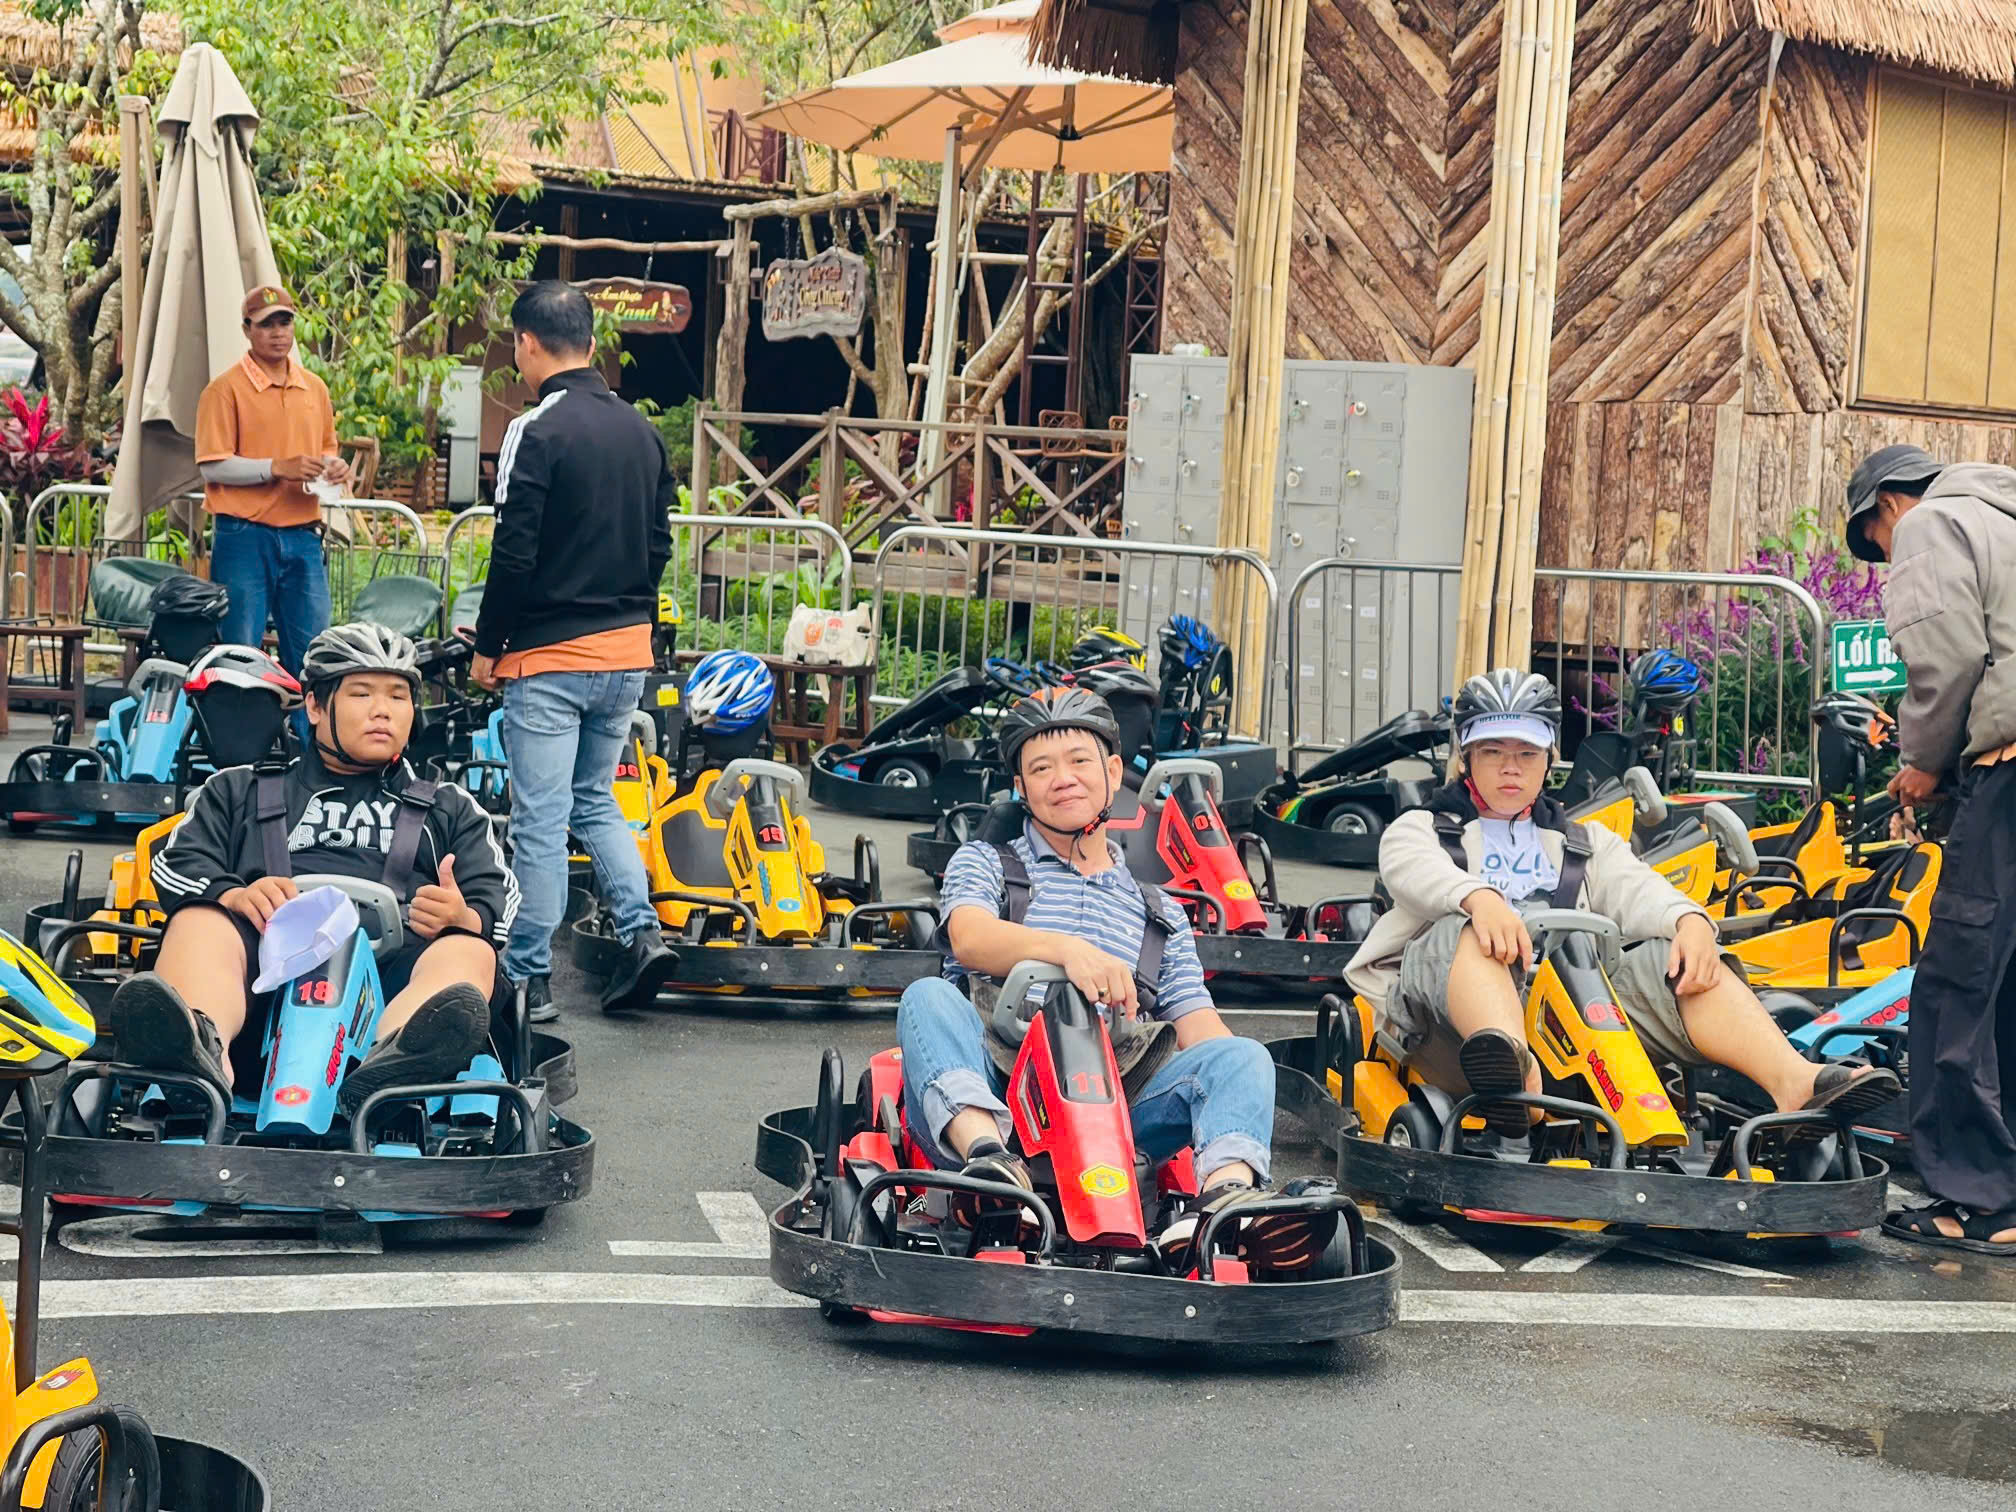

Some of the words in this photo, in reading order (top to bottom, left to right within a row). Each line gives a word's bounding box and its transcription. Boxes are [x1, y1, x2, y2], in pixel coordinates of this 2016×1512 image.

[1837, 629, 1872, 668] LỐI
[300, 797, 397, 831] STAY
[758, 827, 786, 844] 15
[298, 981, 339, 1005] 18
[1071, 1071, 1105, 1097] 11
